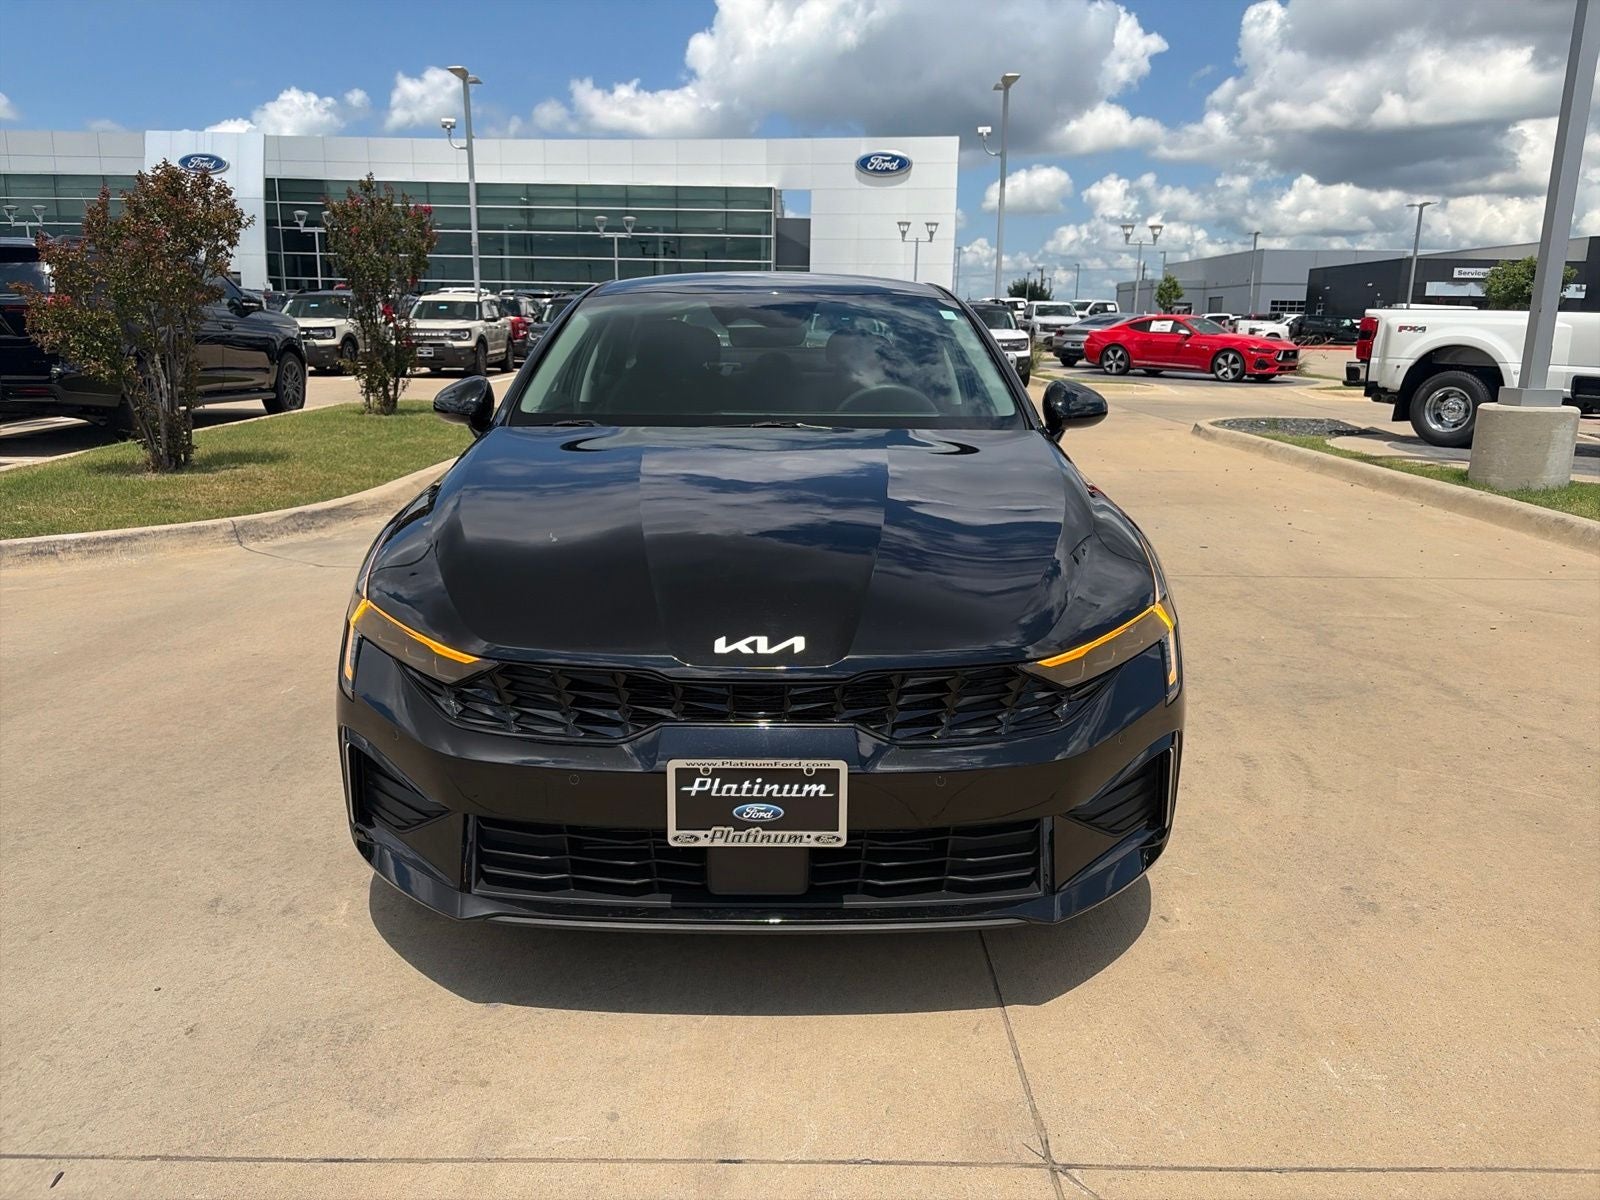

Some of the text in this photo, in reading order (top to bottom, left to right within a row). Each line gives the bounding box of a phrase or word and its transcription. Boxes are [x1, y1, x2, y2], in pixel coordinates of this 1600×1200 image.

[188, 157, 216, 169] Ford
[867, 156, 899, 170] Ford
[1398, 325, 1427, 333] FX4
[714, 636, 805, 654] KIA
[680, 777, 835, 797] Platinum
[742, 806, 774, 819] Ford
[709, 829, 811, 844] Platinum
